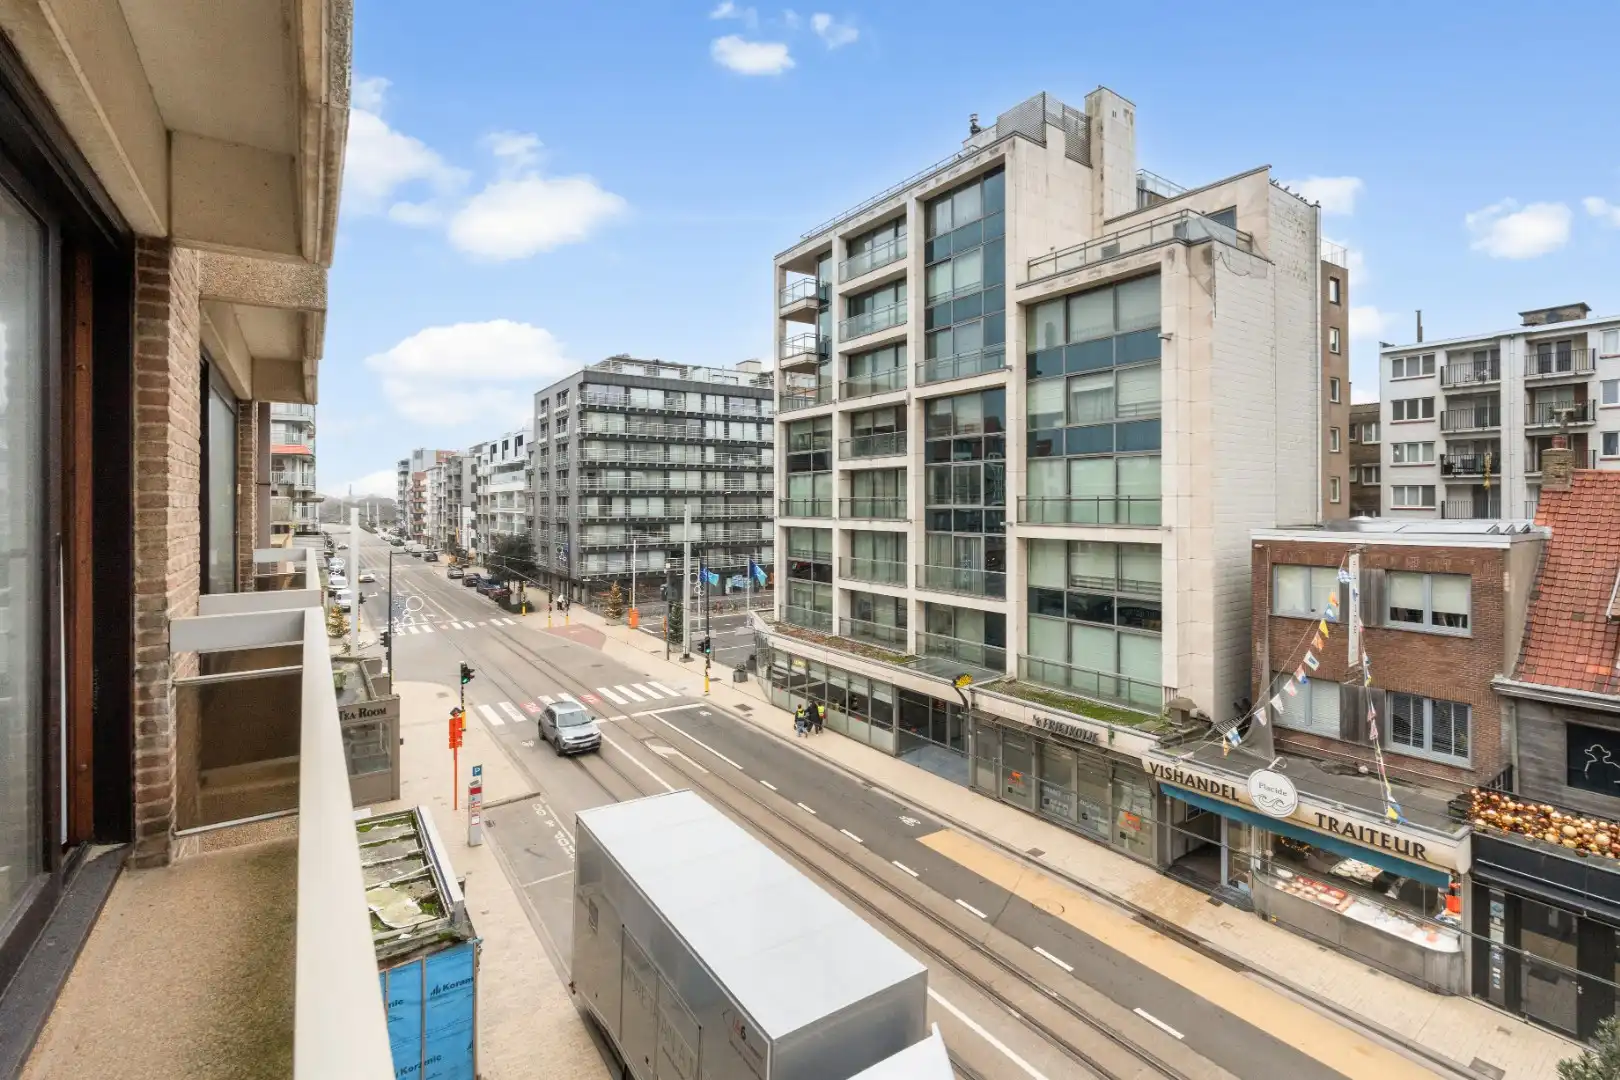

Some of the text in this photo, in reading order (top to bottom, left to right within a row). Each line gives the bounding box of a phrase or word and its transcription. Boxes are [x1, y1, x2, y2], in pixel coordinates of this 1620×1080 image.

[1149, 761, 1240, 802] VISHANDEL
[1258, 781, 1288, 797] Placide
[1314, 812, 1428, 861] TRAITEUR
